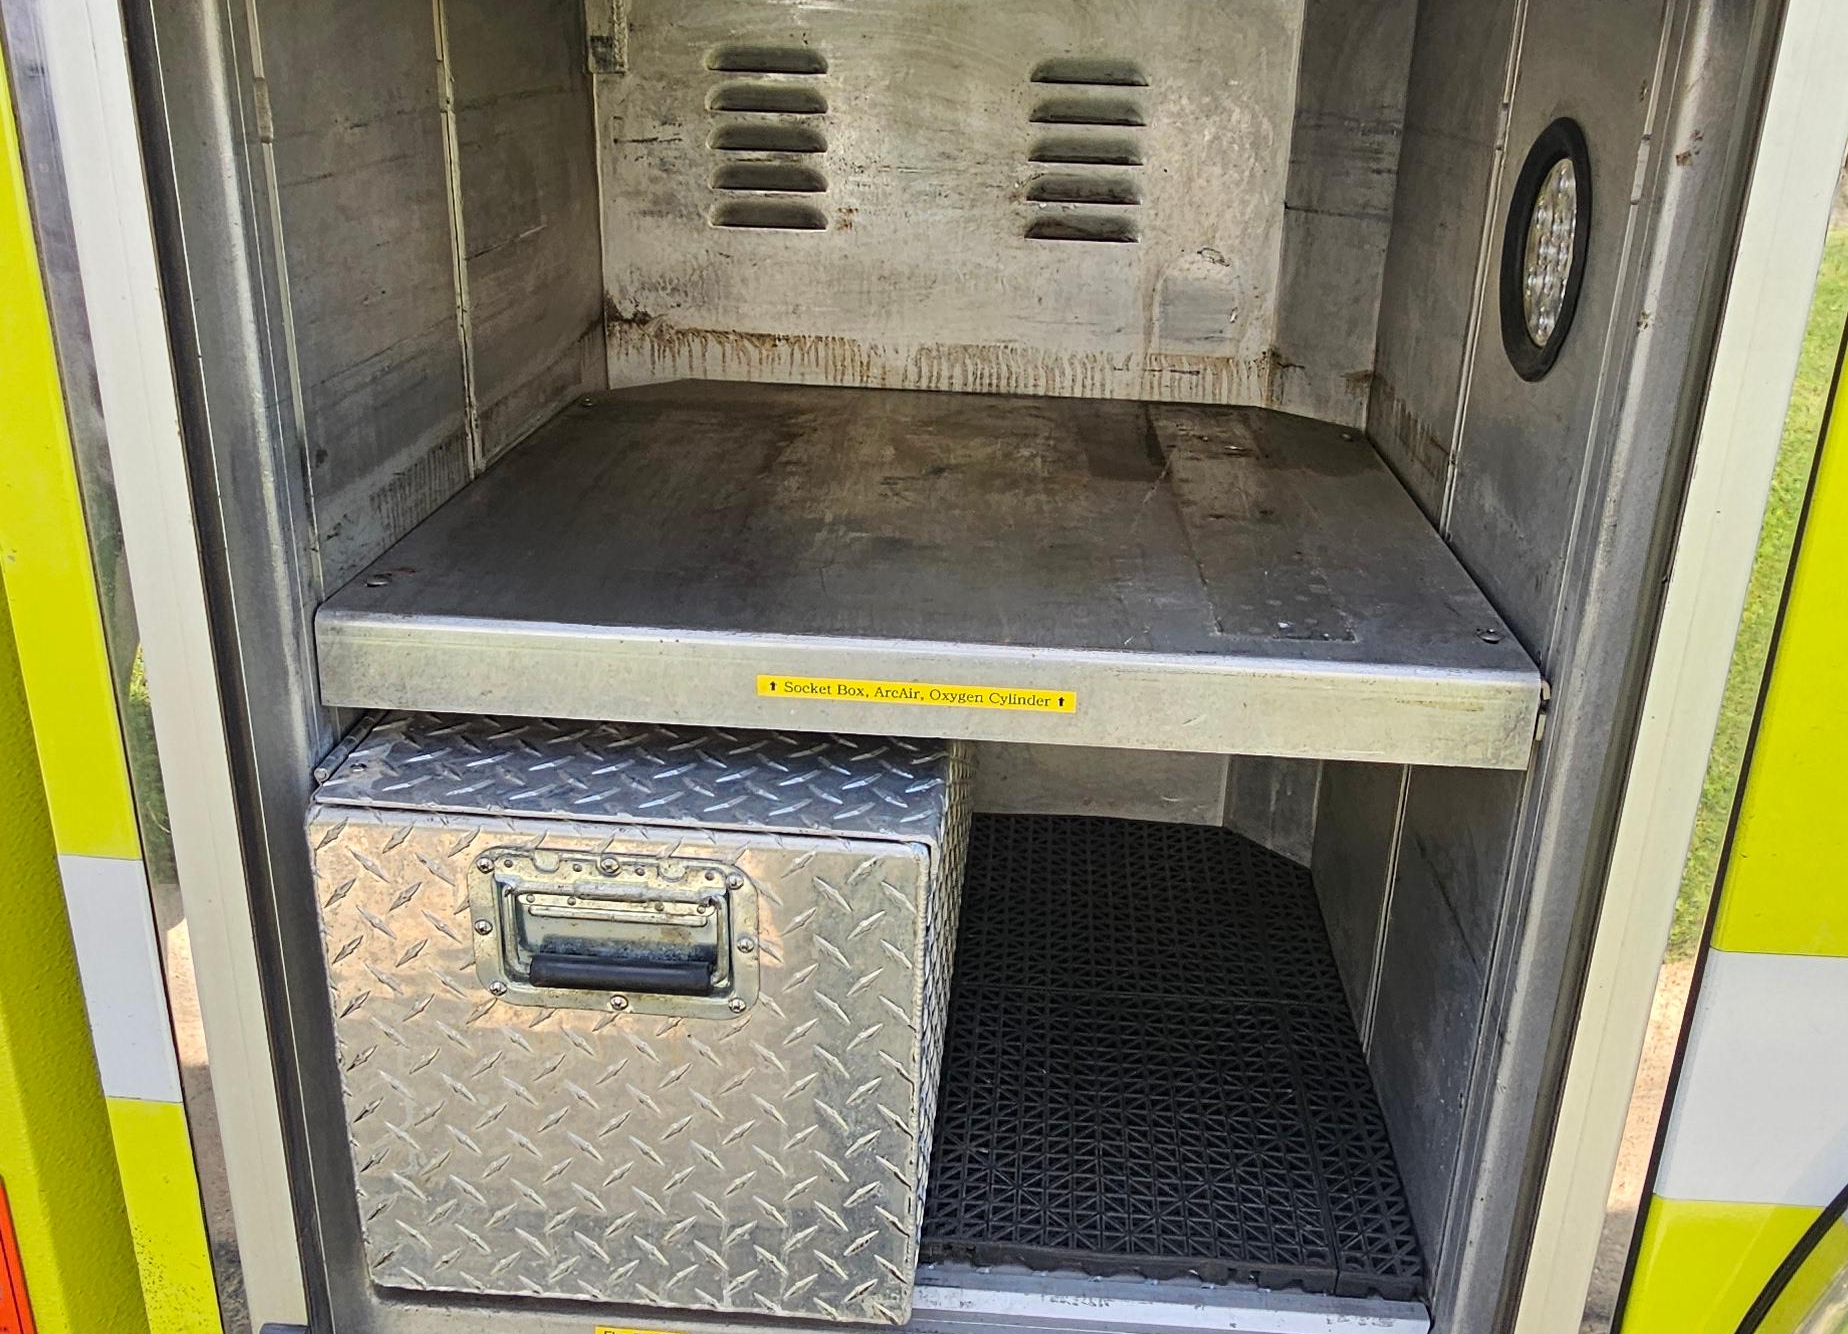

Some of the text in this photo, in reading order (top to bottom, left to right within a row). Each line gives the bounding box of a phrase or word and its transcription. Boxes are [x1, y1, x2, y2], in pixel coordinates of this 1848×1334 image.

[784, 681, 1051, 706] Socket Box, ArcAir, Oxygen Cylinder
